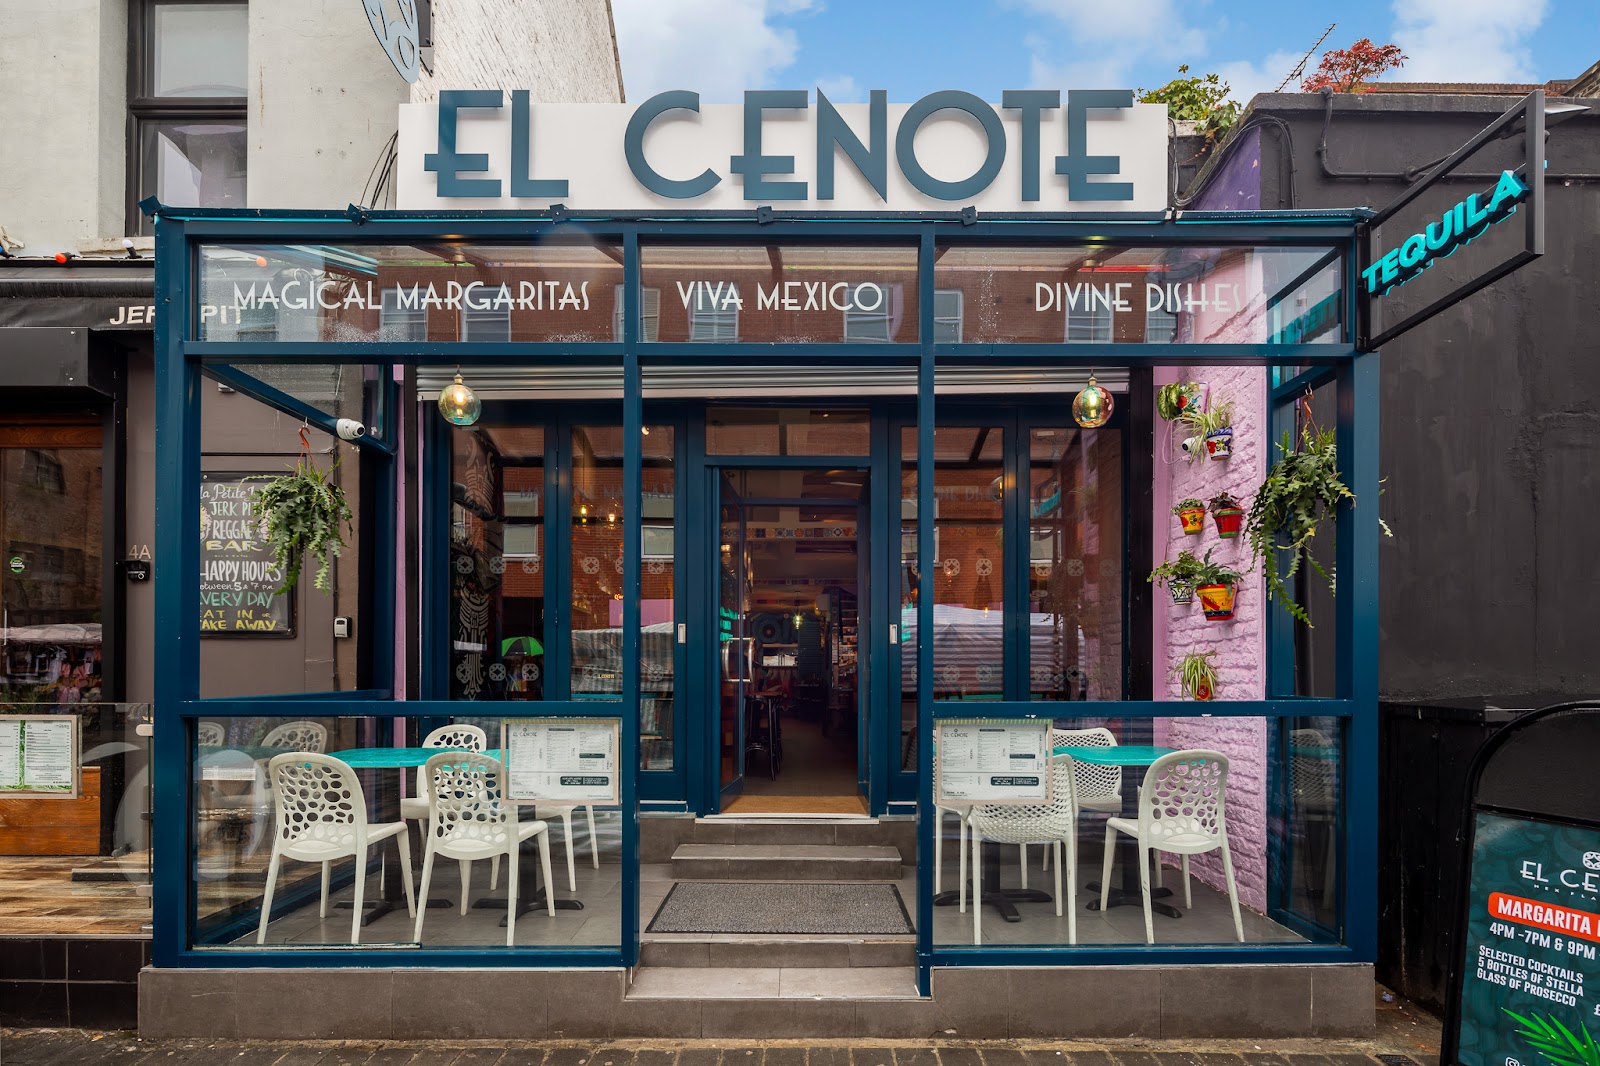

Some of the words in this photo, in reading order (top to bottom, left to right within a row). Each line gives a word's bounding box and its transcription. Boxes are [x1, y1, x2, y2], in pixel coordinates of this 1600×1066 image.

[424, 89, 569, 198] EL
[623, 86, 1134, 203] CENOTE
[1361, 170, 1528, 294] TEQUILA
[233, 281, 383, 311] MAGICAL
[396, 281, 590, 311] MARGARITAS
[676, 281, 744, 311] VIVA
[757, 281, 883, 312] MEXICO
[1035, 282, 1133, 312] DIVINE
[1146, 282, 1242, 312] DISHES
[200, 305, 241, 325] PIT
[211, 483, 246, 501] Petite
[209, 501, 238, 517] JERK
[212, 519, 255, 540] REGGAE
[128, 544, 151, 560] 4A
[205, 540, 263, 552] BAR
[242, 560, 282, 582] HOURS
[233, 582, 242, 591] 5
[250, 581, 259, 590] 7
[200, 591, 244, 607] VERY
[247, 591, 275, 609] DAY
[200, 609, 226, 619] AT
[237, 609, 254, 620] IN
[200, 619, 227, 631] AKE
[235, 619, 278, 631] AWAY
[1520, 860, 1549, 883] EL
[1497, 896, 1592, 935] MARGARITA
[1489, 922, 1515, 940] 4PM
[1554, 937, 1564, 952] &
[1567, 941, 1596, 960] 9PM
[1479, 945, 1525, 967] SELECTED
[1527, 958, 1584, 984] COCKTAILS
[1476, 967, 1507, 986] GLASS
[1508, 978, 1522, 991] OF
[1524, 981, 1577, 1007] PROSECCO
[1478, 956, 1485, 967] 5
[1486, 958, 1529, 981] BOTTLES
[1530, 972, 1544, 984] OF
[1546, 976, 1584, 997] STELLA
